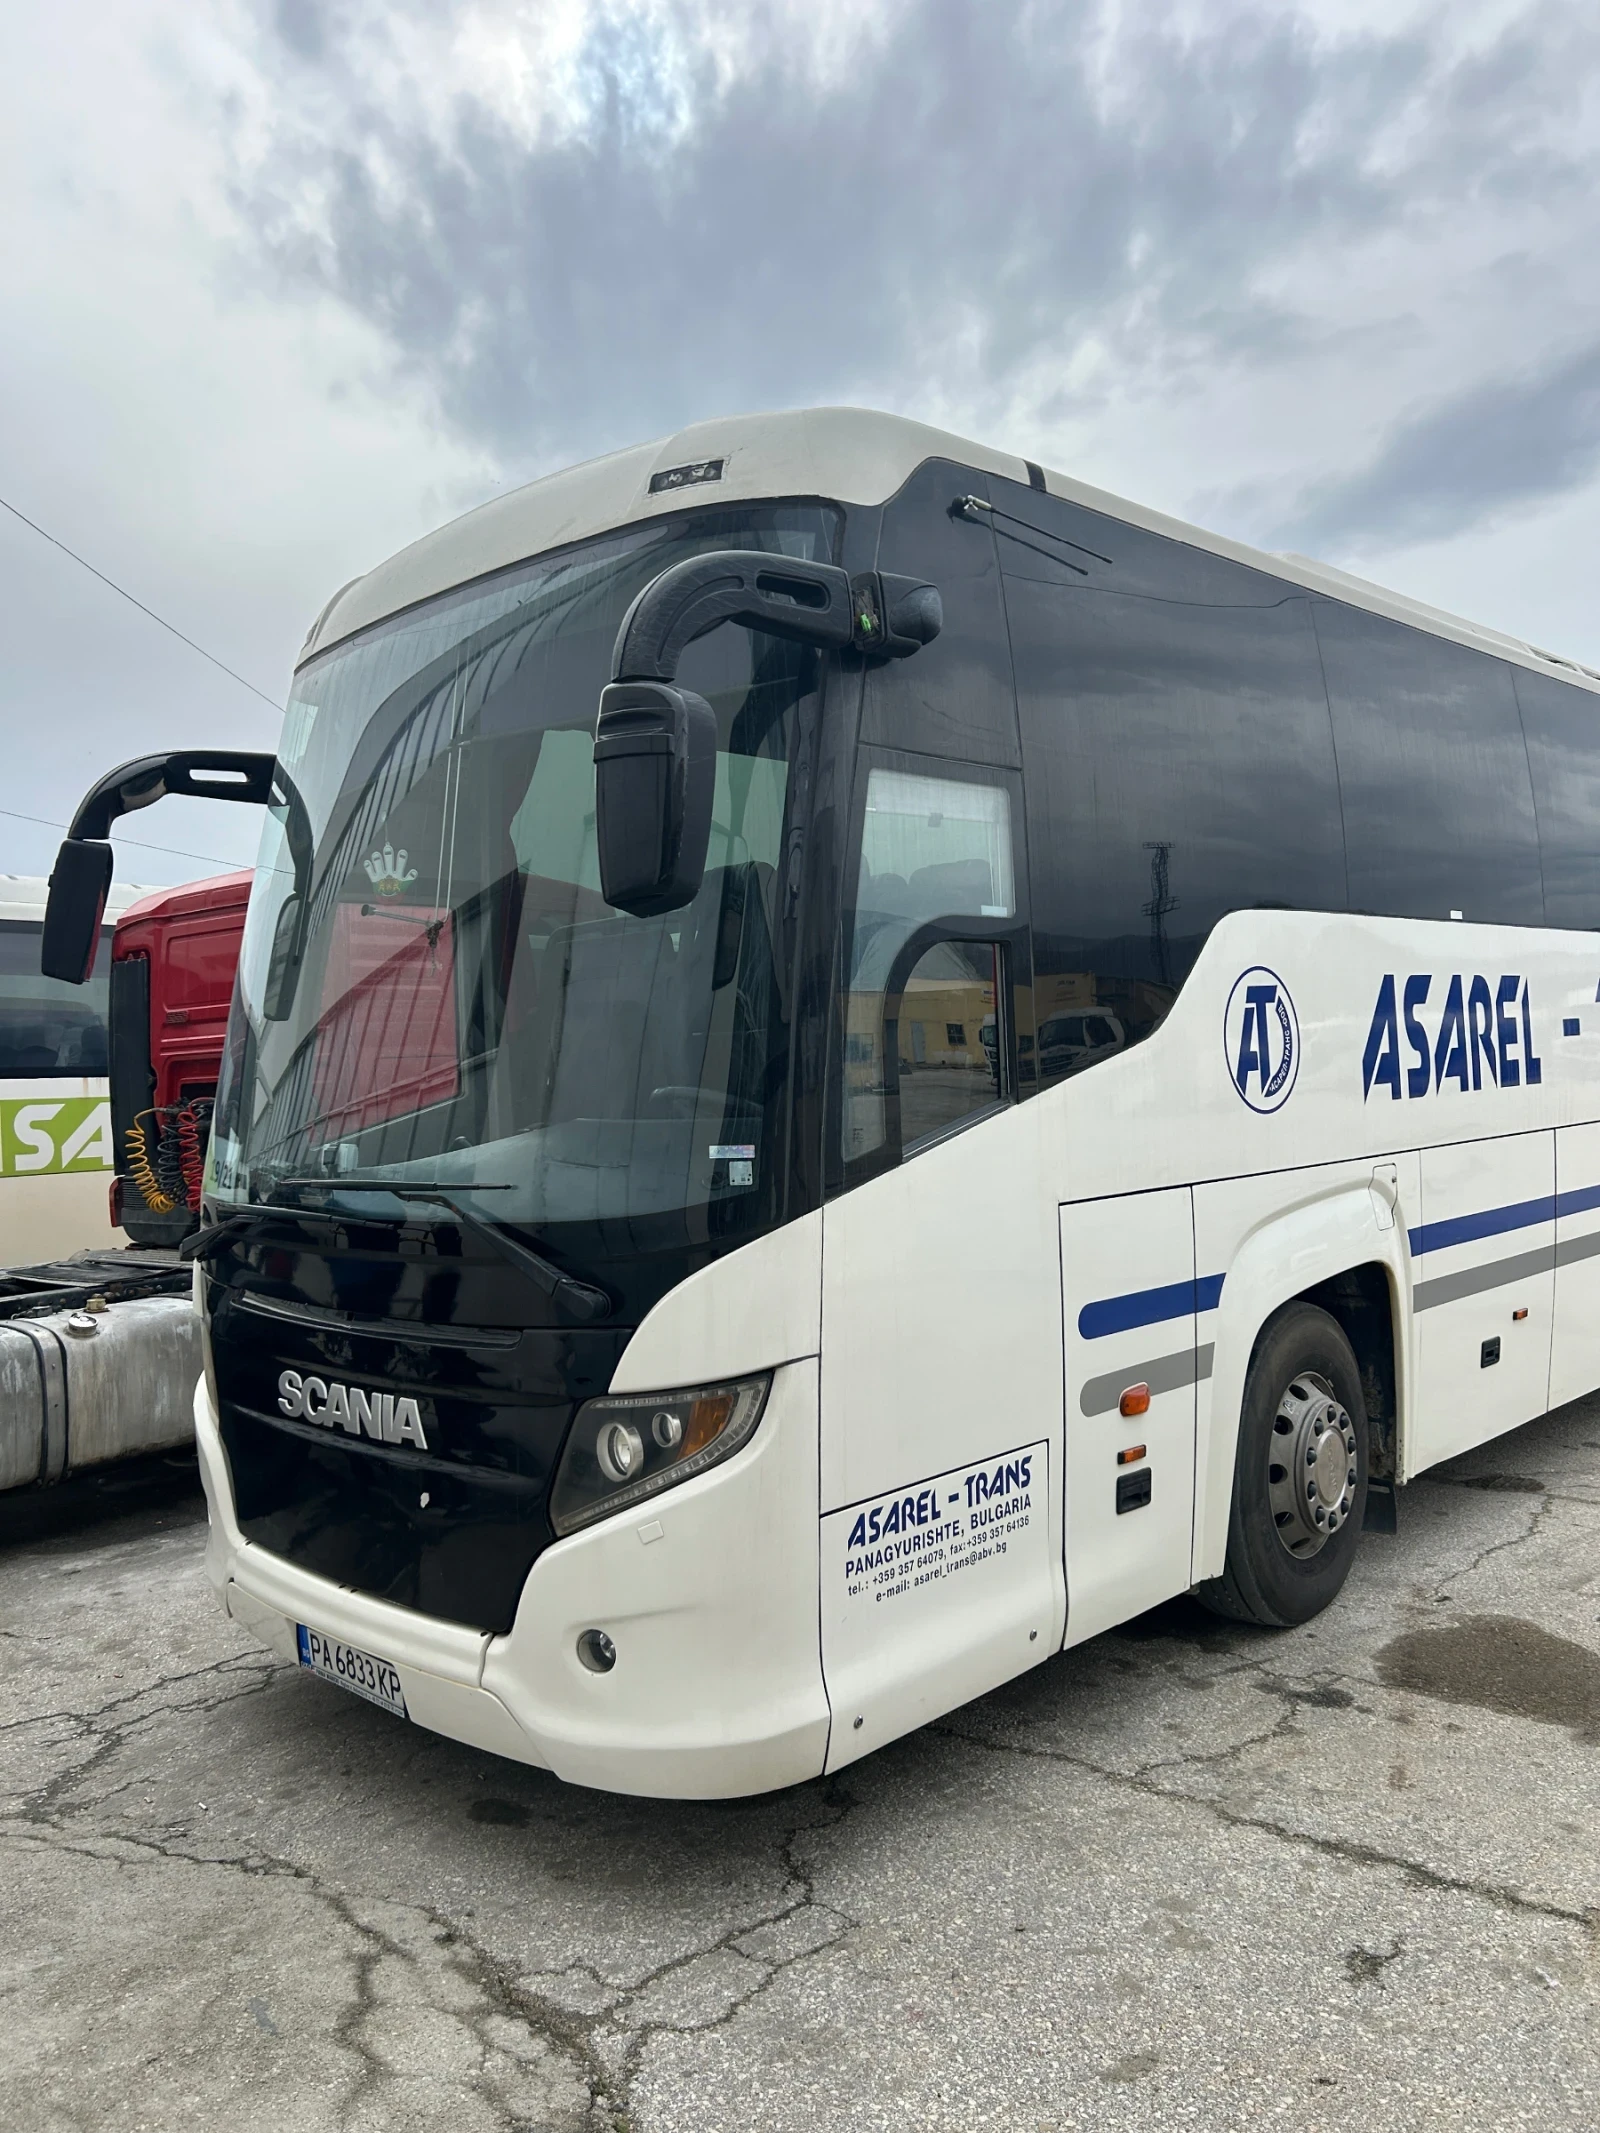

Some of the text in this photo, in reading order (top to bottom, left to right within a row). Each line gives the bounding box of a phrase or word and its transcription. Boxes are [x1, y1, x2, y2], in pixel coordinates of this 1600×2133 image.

[1362, 974, 1541, 1105] ASAREL
[278, 1370, 428, 1450] SCANIA
[846, 1494, 1031, 1579] PANAGYURISHTE, BULGARIA
[848, 1488, 941, 1552] ASAREL
[964, 1455, 1032, 1508] TRANS
[873, 1567, 895, 1585] +359
[898, 1560, 915, 1576] 357
[917, 1549, 947, 1568] 64079,
[989, 1525, 1005, 1540] 357
[1006, 1515, 1029, 1533] 64136
[876, 1542, 1007, 1602] e-mail: asarel_trans@abv.bg
